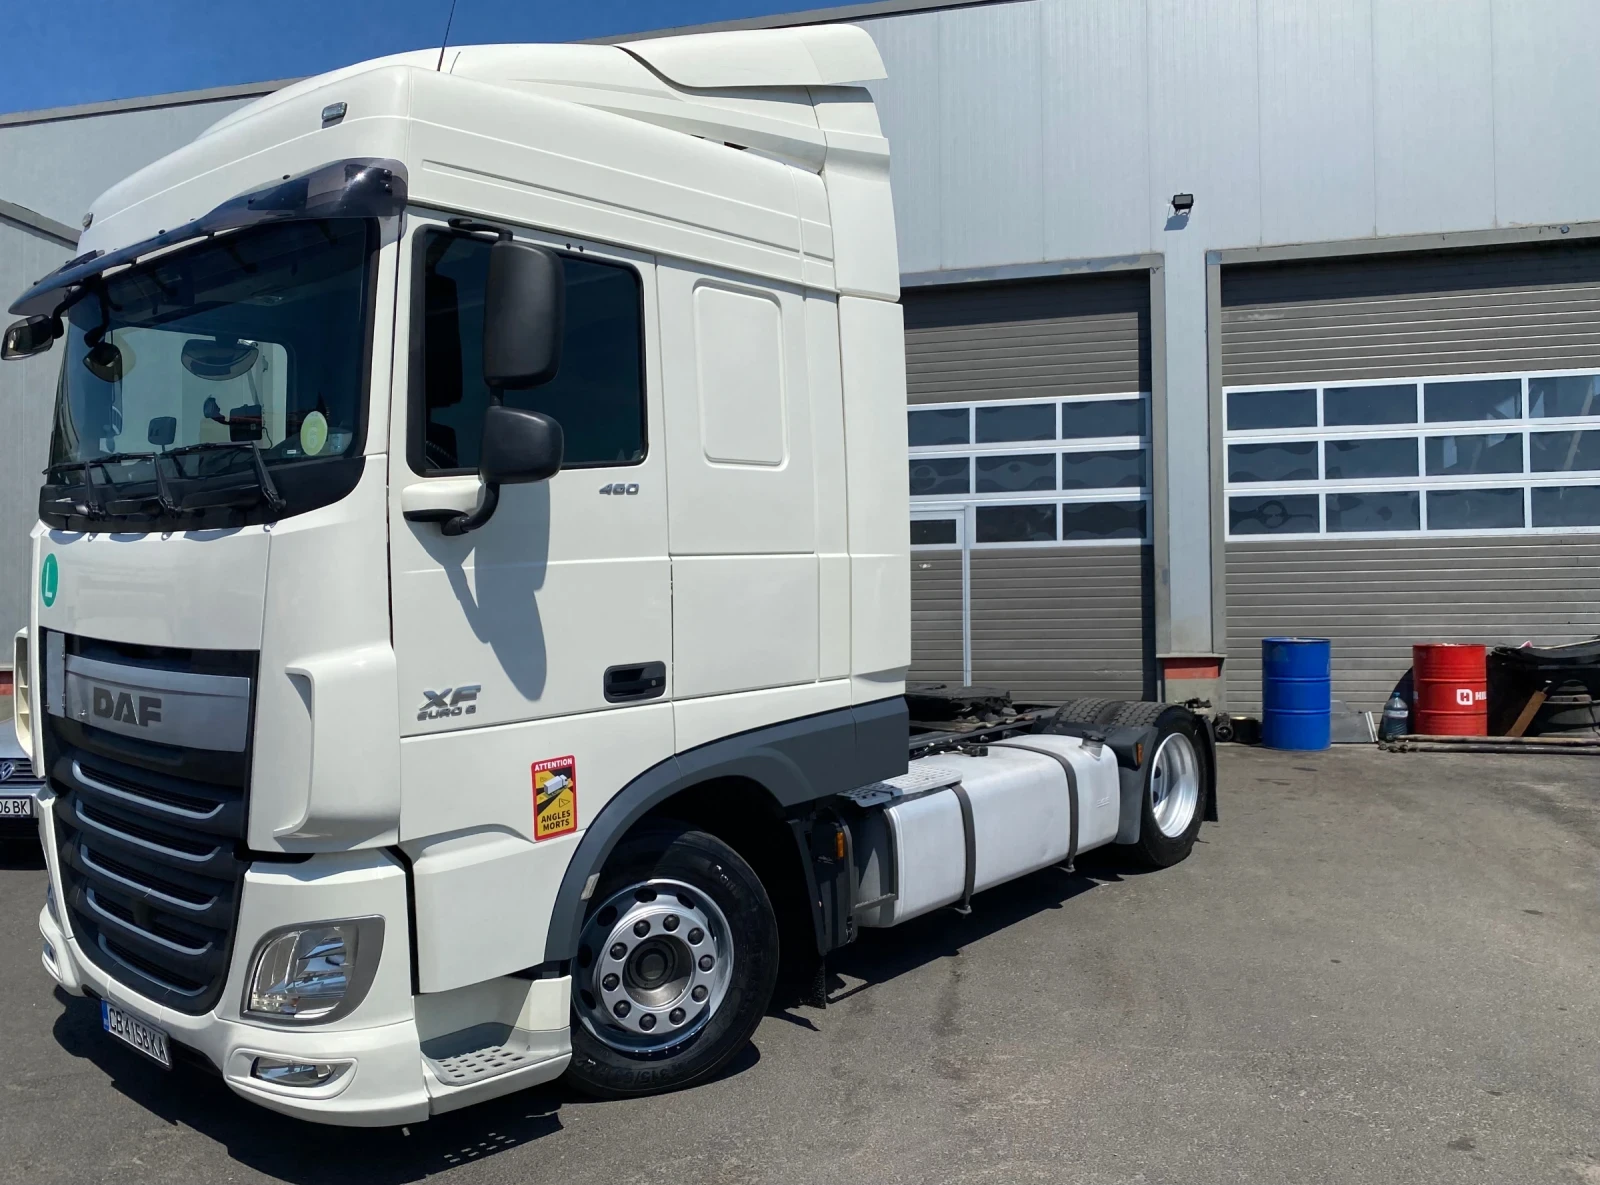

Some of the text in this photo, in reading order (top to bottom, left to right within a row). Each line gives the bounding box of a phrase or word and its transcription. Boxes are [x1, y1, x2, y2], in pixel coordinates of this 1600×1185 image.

[45, 562, 53, 598] L
[419, 684, 481, 709] XF
[93, 686, 162, 727] DAF
[417, 707, 462, 721] EURO
[534, 757, 573, 772] ATTENTION
[541, 809, 571, 823] ANGLES
[543, 818, 570, 831] MORTS
